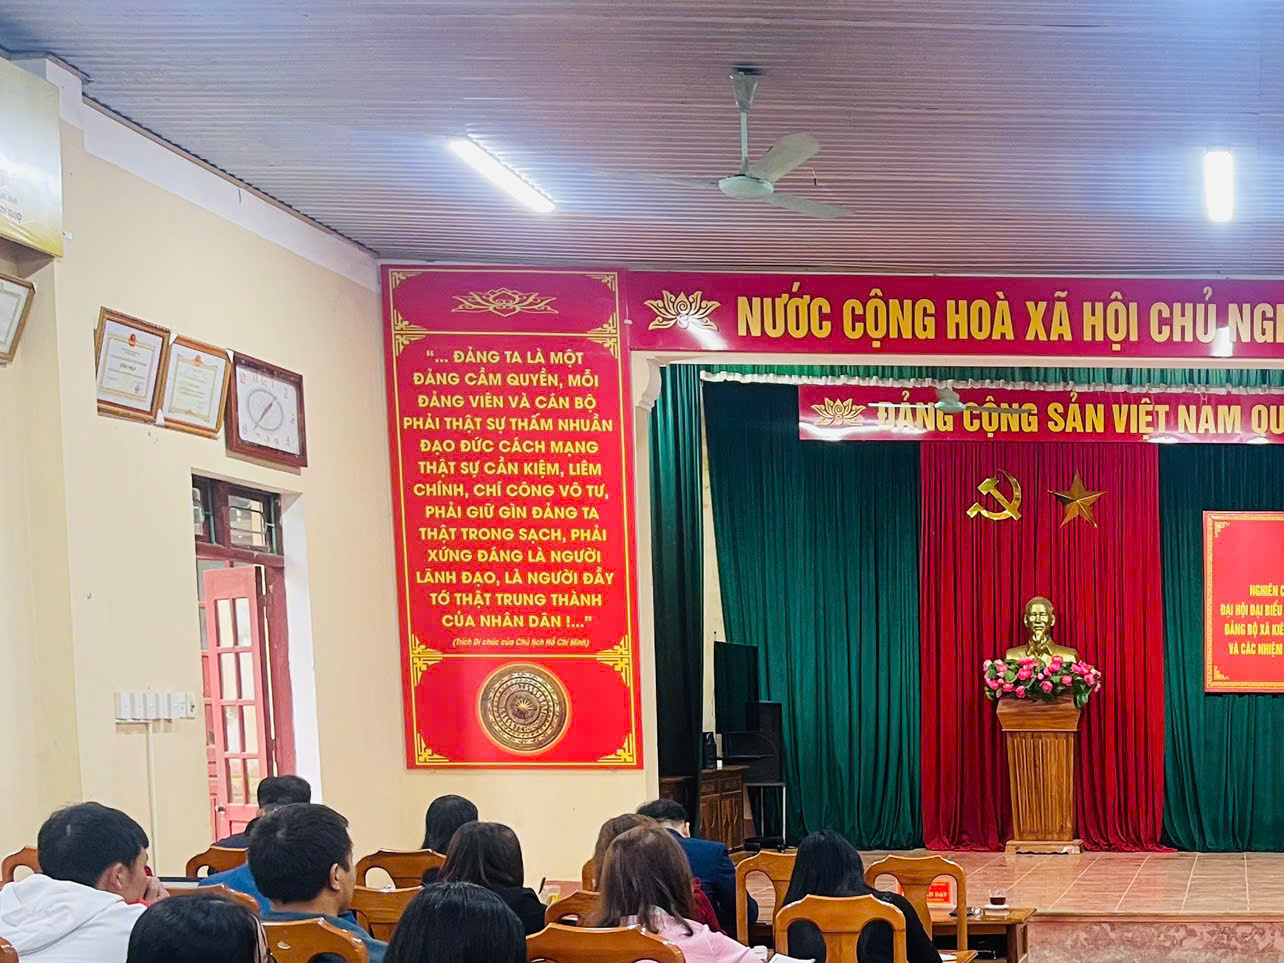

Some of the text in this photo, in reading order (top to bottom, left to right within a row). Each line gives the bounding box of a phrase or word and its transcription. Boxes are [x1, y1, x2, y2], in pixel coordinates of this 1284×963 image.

[737, 282, 831, 339] NƯỚC
[843, 288, 936, 348] CỘNG
[947, 291, 1015, 341] HOÀ
[1025, 291, 1073, 342] XÃ
[1082, 291, 1139, 351] HỘI
[1149, 286, 1217, 344] CHỦ
[414, 368, 460, 385] ĐẢNG
[465, 367, 501, 385] CẦM
[568, 369, 598, 387] MỖI
[417, 390, 597, 413] ĐẢNG VIÊN VÀ CÁN BỘ
[403, 410, 613, 434] PHẢI THẬT SỰ THẤM NHUẦN
[876, 390, 954, 433] ĐẢNG
[963, 395, 1039, 438] CỘNG
[1047, 391, 1105, 433] SẢN
[1111, 397, 1170, 440] VIỆT
[1177, 404, 1242, 434] NAM
[420, 436, 599, 457] ĐẠO ĐỨC CÁCH MẠNG
[425, 501, 600, 519] PHẢI GIỮ GÌN ĐẢNG TA
[418, 524, 457, 543] THẬT
[460, 527, 515, 540] TRONG
[570, 524, 607, 541] PHẢI
[427, 546, 601, 563] XỨNG ĐÁNG LÀ NGƯỜI
[416, 568, 457, 583] LÃNH
[504, 568, 523, 584] LÀ
[527, 568, 579, 584] NGƯỜI
[582, 566, 615, 584] ĐẦY
[1228, 642, 1239, 654] VÀ
[1240, 641, 1256, 654] CÁC
